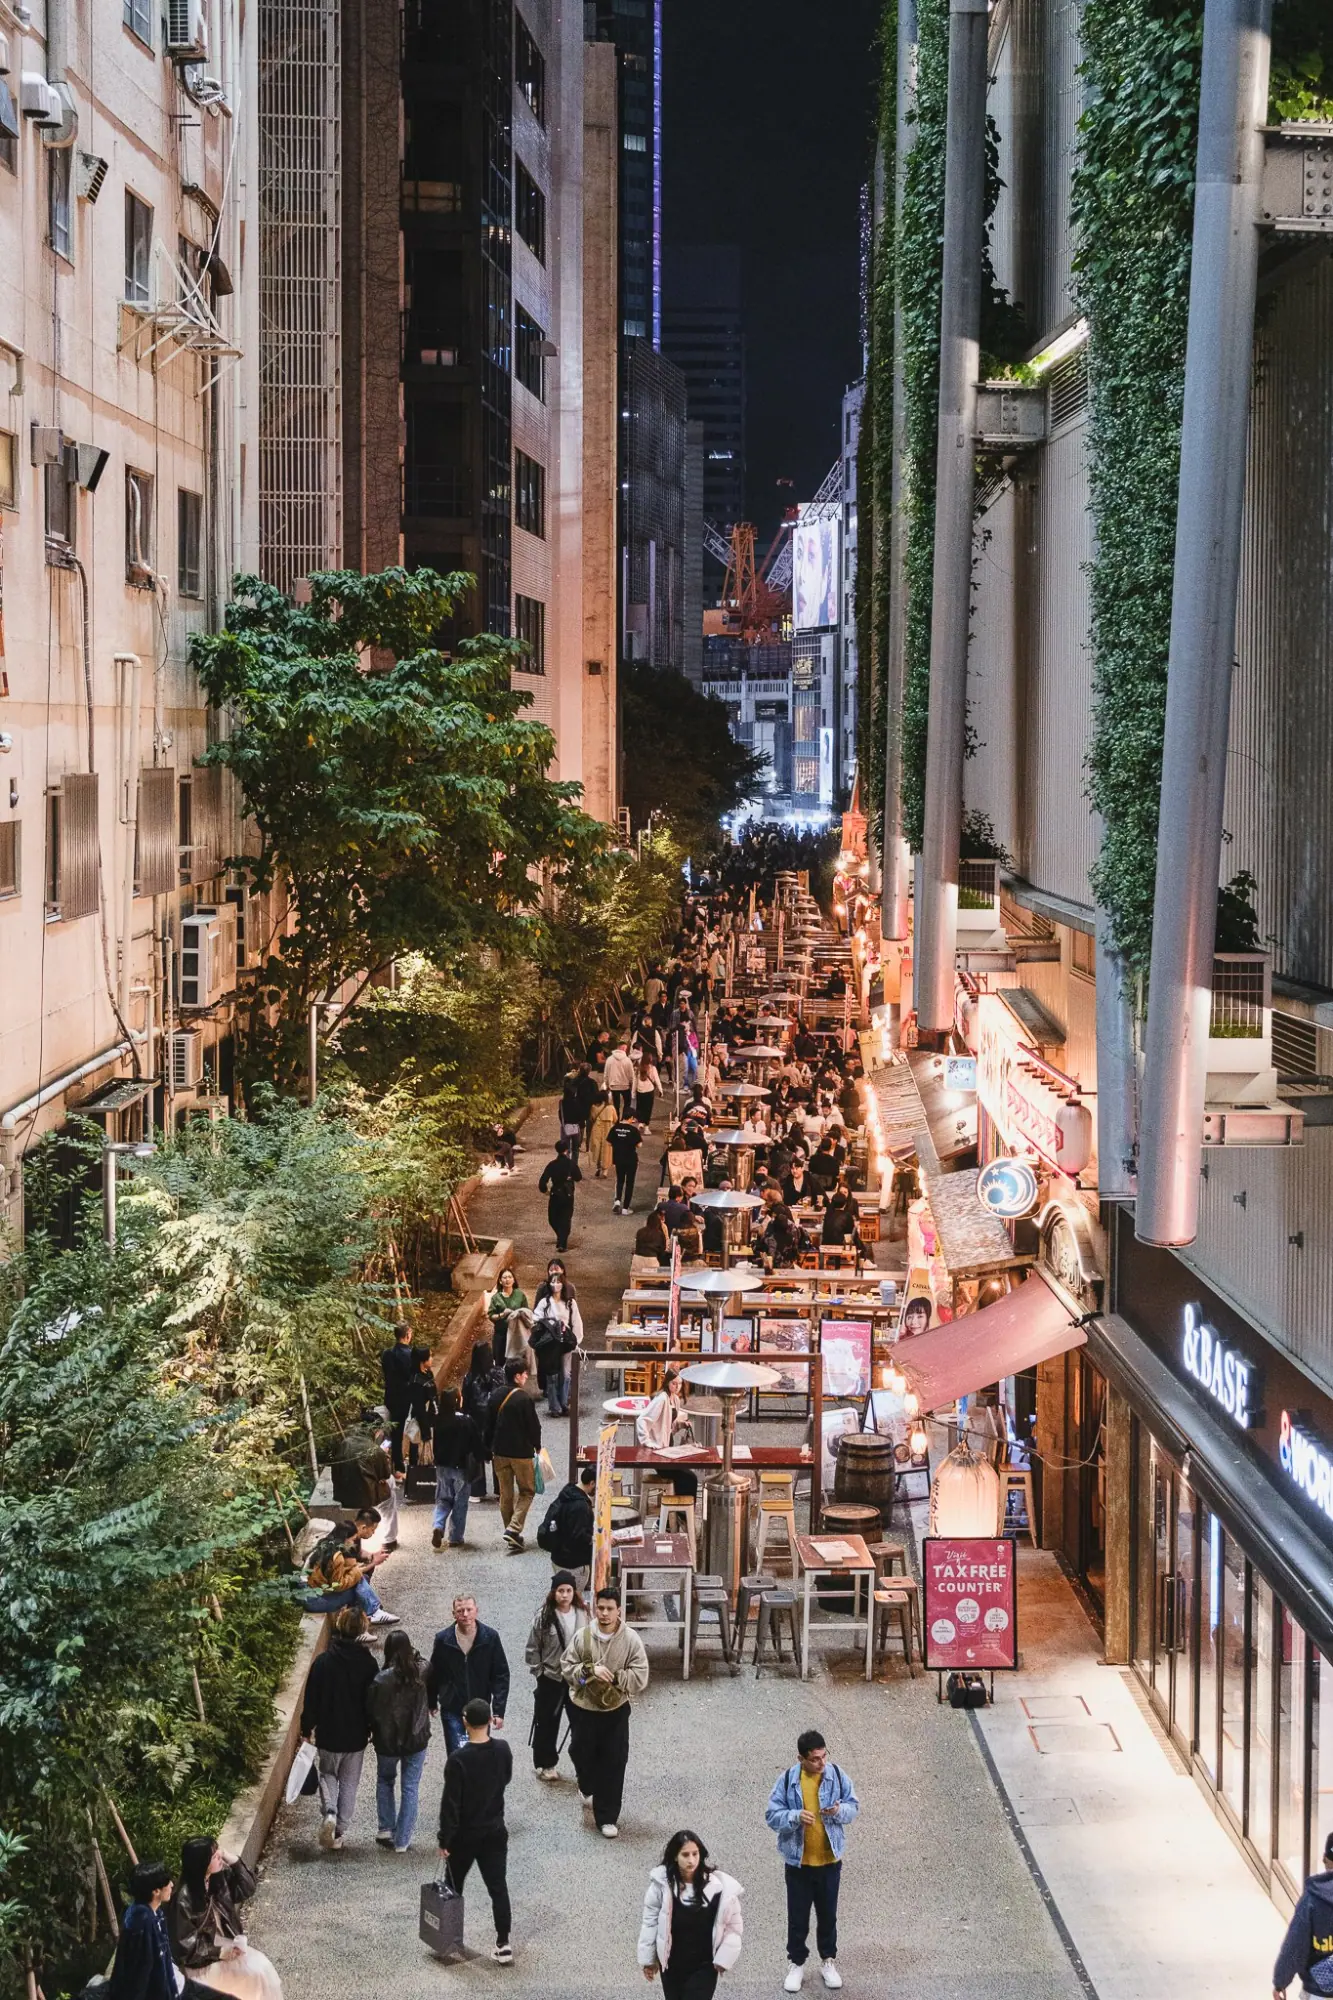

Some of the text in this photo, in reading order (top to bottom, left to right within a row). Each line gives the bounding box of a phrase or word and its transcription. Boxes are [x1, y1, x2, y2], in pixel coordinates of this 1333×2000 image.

[1183, 1303, 1249, 1430] &BASE
[1279, 1409, 1333, 1521] &WOR
[944, 1550, 968, 1562] Visit
[938, 1582, 1001, 1595] COUNTER
